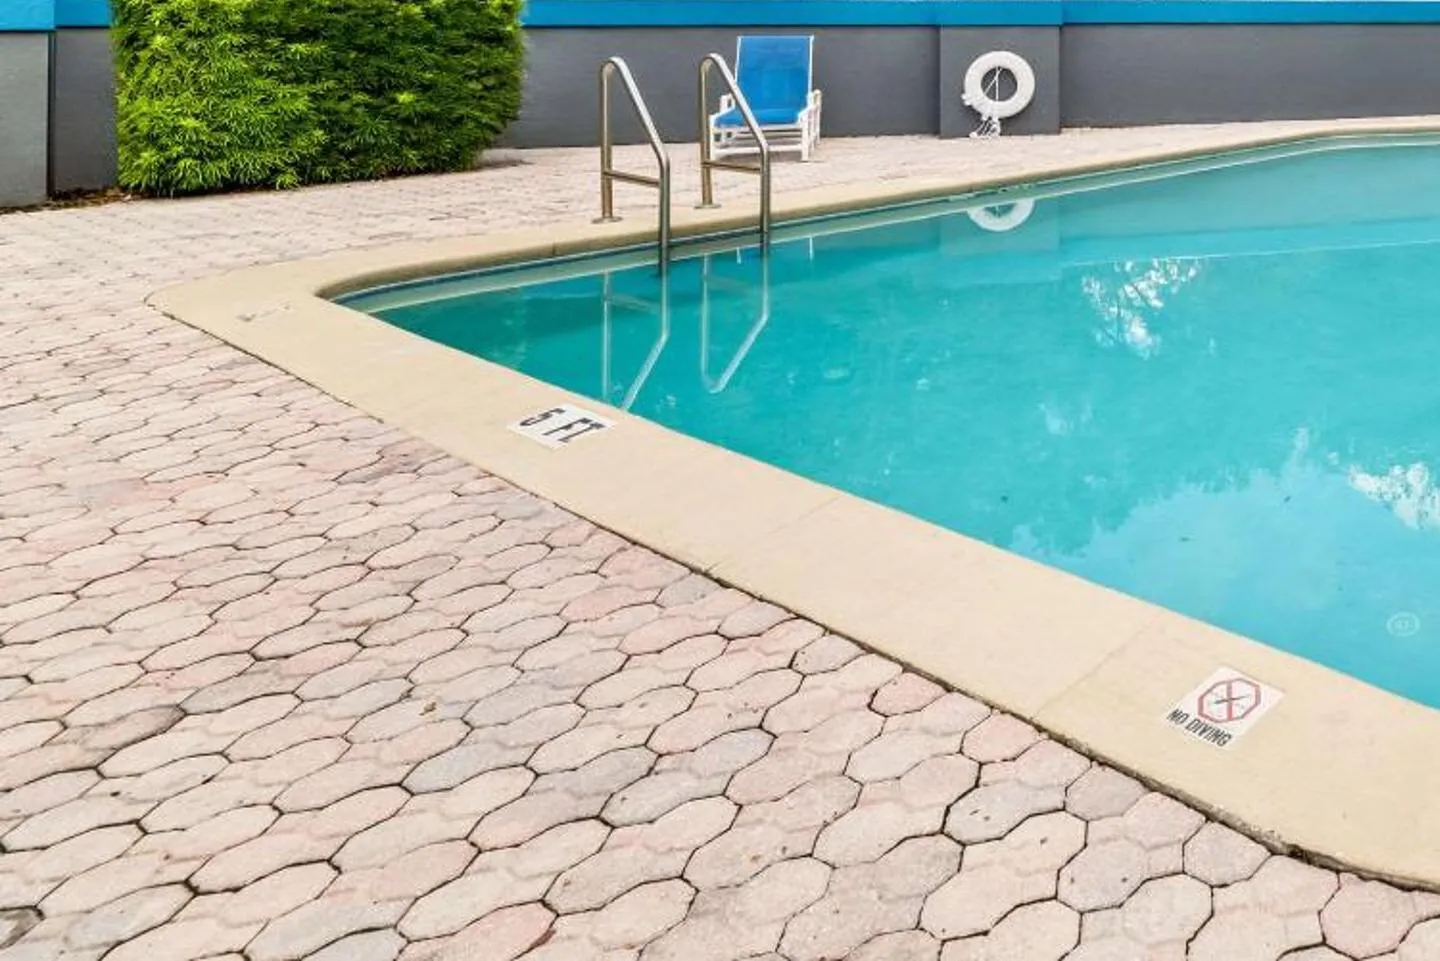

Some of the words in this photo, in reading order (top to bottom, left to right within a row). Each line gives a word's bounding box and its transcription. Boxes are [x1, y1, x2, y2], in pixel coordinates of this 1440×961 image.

[519, 407, 566, 427] 5
[541, 417, 606, 443] FT
[1166, 708, 1190, 725] NO
[1184, 719, 1232, 747] DIVING
